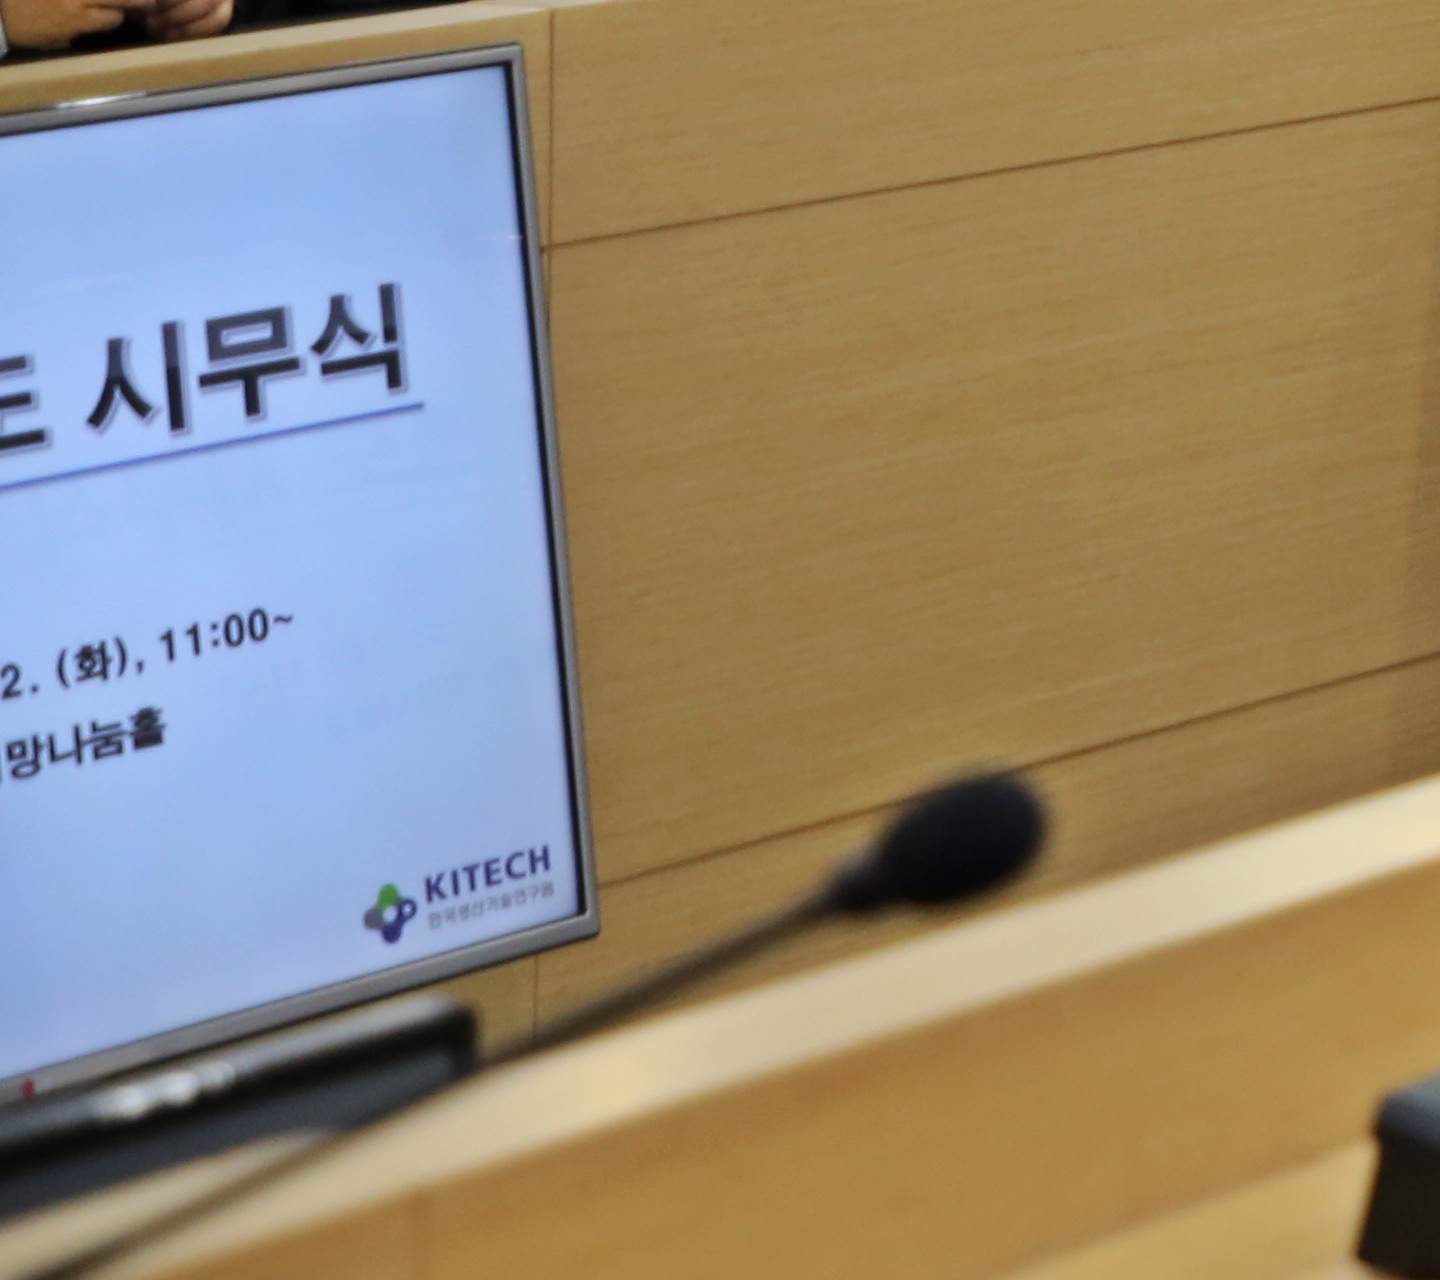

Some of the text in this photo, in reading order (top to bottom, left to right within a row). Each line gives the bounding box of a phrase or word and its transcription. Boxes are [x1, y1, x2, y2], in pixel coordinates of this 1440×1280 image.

[87, 282, 408, 436] 시무식
[56, 636, 146, 689] (화),
[159, 607, 294, 663] 11:00~
[0, 706, 167, 781] 망나눔홀
[423, 844, 552, 904] KITECH
